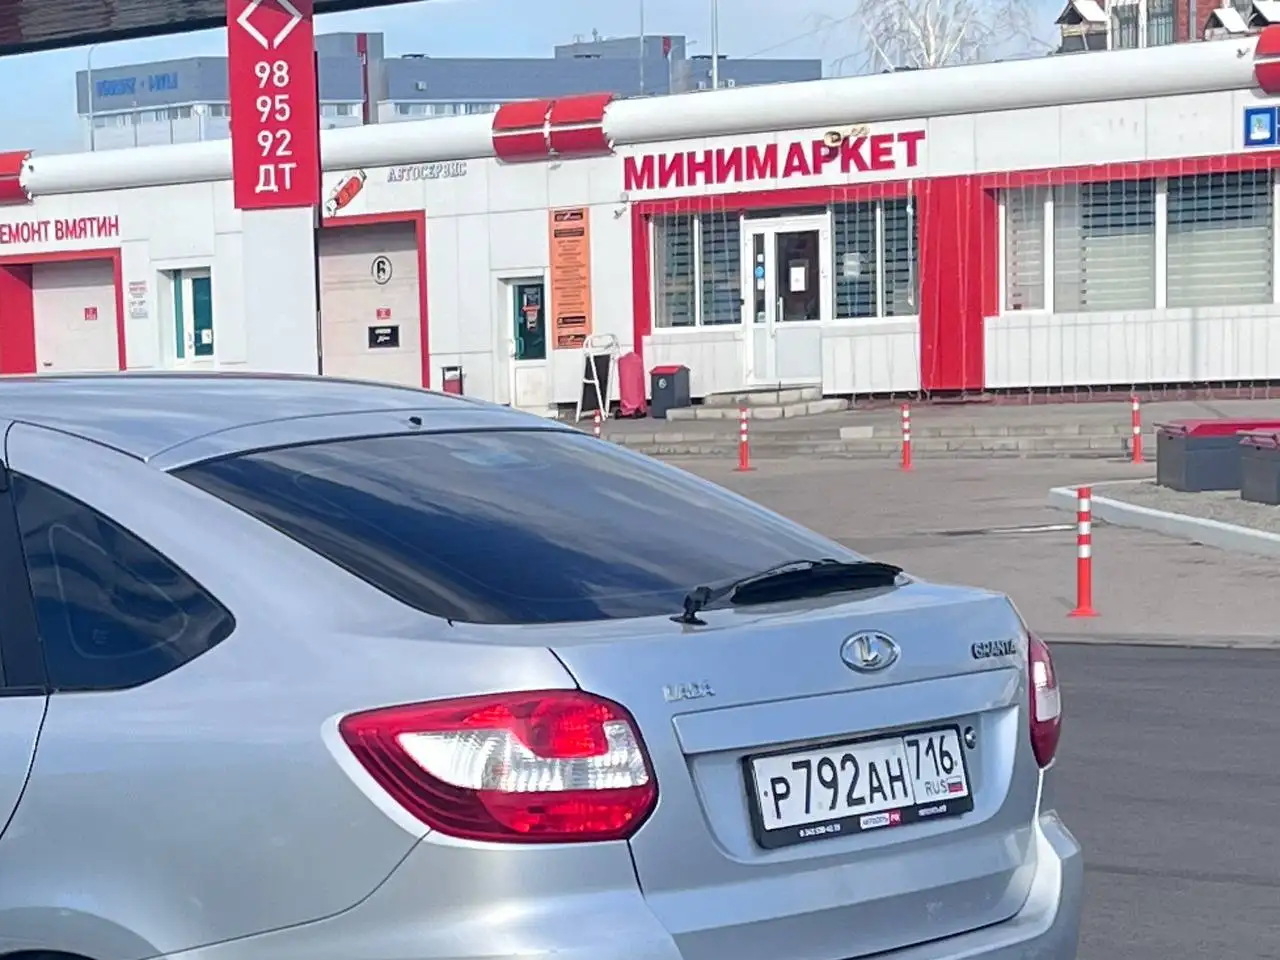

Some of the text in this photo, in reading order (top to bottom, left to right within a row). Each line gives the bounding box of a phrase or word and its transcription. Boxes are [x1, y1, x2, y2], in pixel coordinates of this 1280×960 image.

[255, 60, 289, 88] 98
[256, 95, 291, 122] 95
[257, 130, 293, 157] 92
[623, 130, 925, 191] МИНИМАРКЕТ
[255, 163, 297, 193] ДТ
[54, 215, 119, 241] ВМЯТИН
[770, 735, 956, 820] Р792АН 716
[924, 779, 948, 796] RUS
